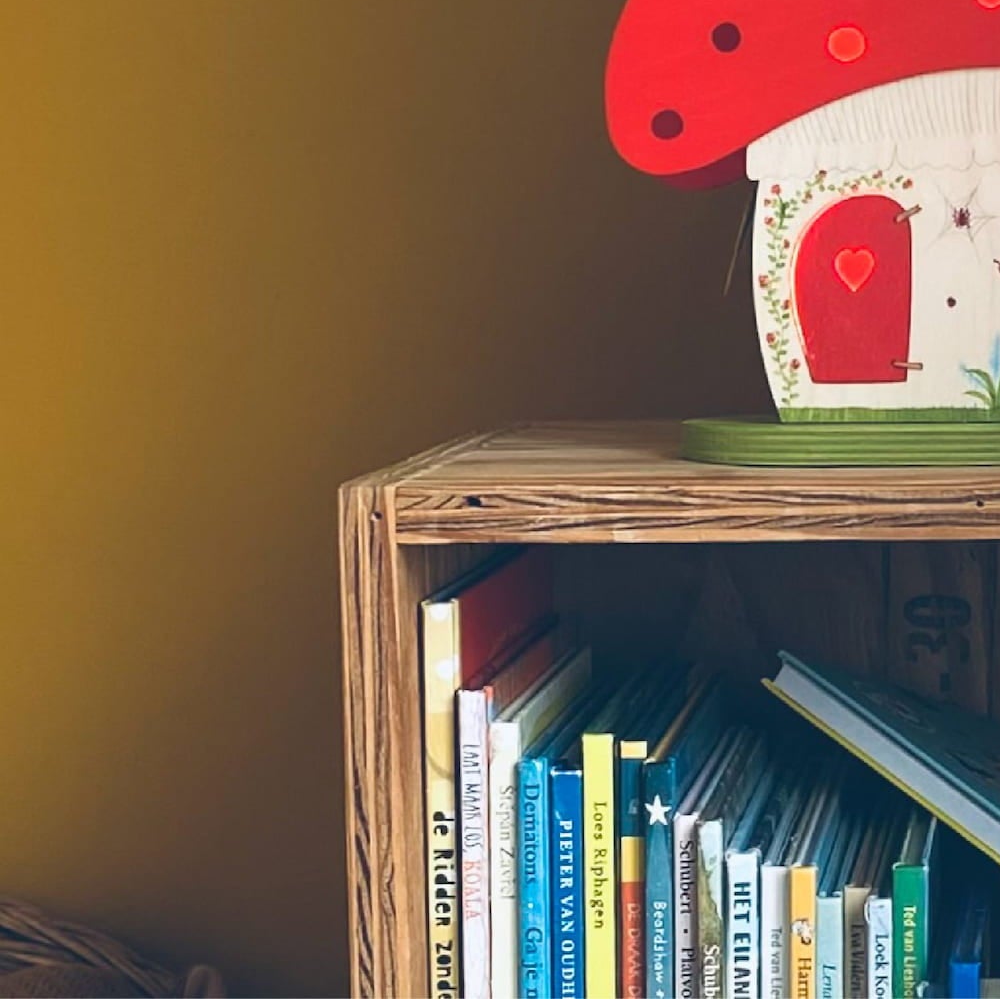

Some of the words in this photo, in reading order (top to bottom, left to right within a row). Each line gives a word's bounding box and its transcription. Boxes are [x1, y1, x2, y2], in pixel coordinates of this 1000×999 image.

[433, 811, 455, 835] de
[523, 783, 541, 884] Dematons
[594, 801, 607, 840] Loes
[559, 820, 574, 888] PIETER
[464, 859, 482, 920] KOALA
[590, 848, 608, 929] Riphagen
[680, 840, 697, 914] Schubert
[560, 895, 575, 932] VAN
[627, 903, 642, 921] DE
[734, 882, 751, 923] HET
[904, 906, 917, 927] Ted
[525, 927, 543, 954] Ga
[653, 901, 668, 983] Beardshaw
[771, 927, 783, 947] Ted
[904, 929, 915, 952] van
[521, 959, 543, 979] je
[560, 939, 575, 999] OUDH
[681, 948, 697, 999] Platvo
[734, 932, 751, 999] EILAN
[771, 951, 780, 973] van
[904, 956, 917, 999] Liesho
[771, 977, 783, 999] Lie
[875, 976, 889, 999] Ko
